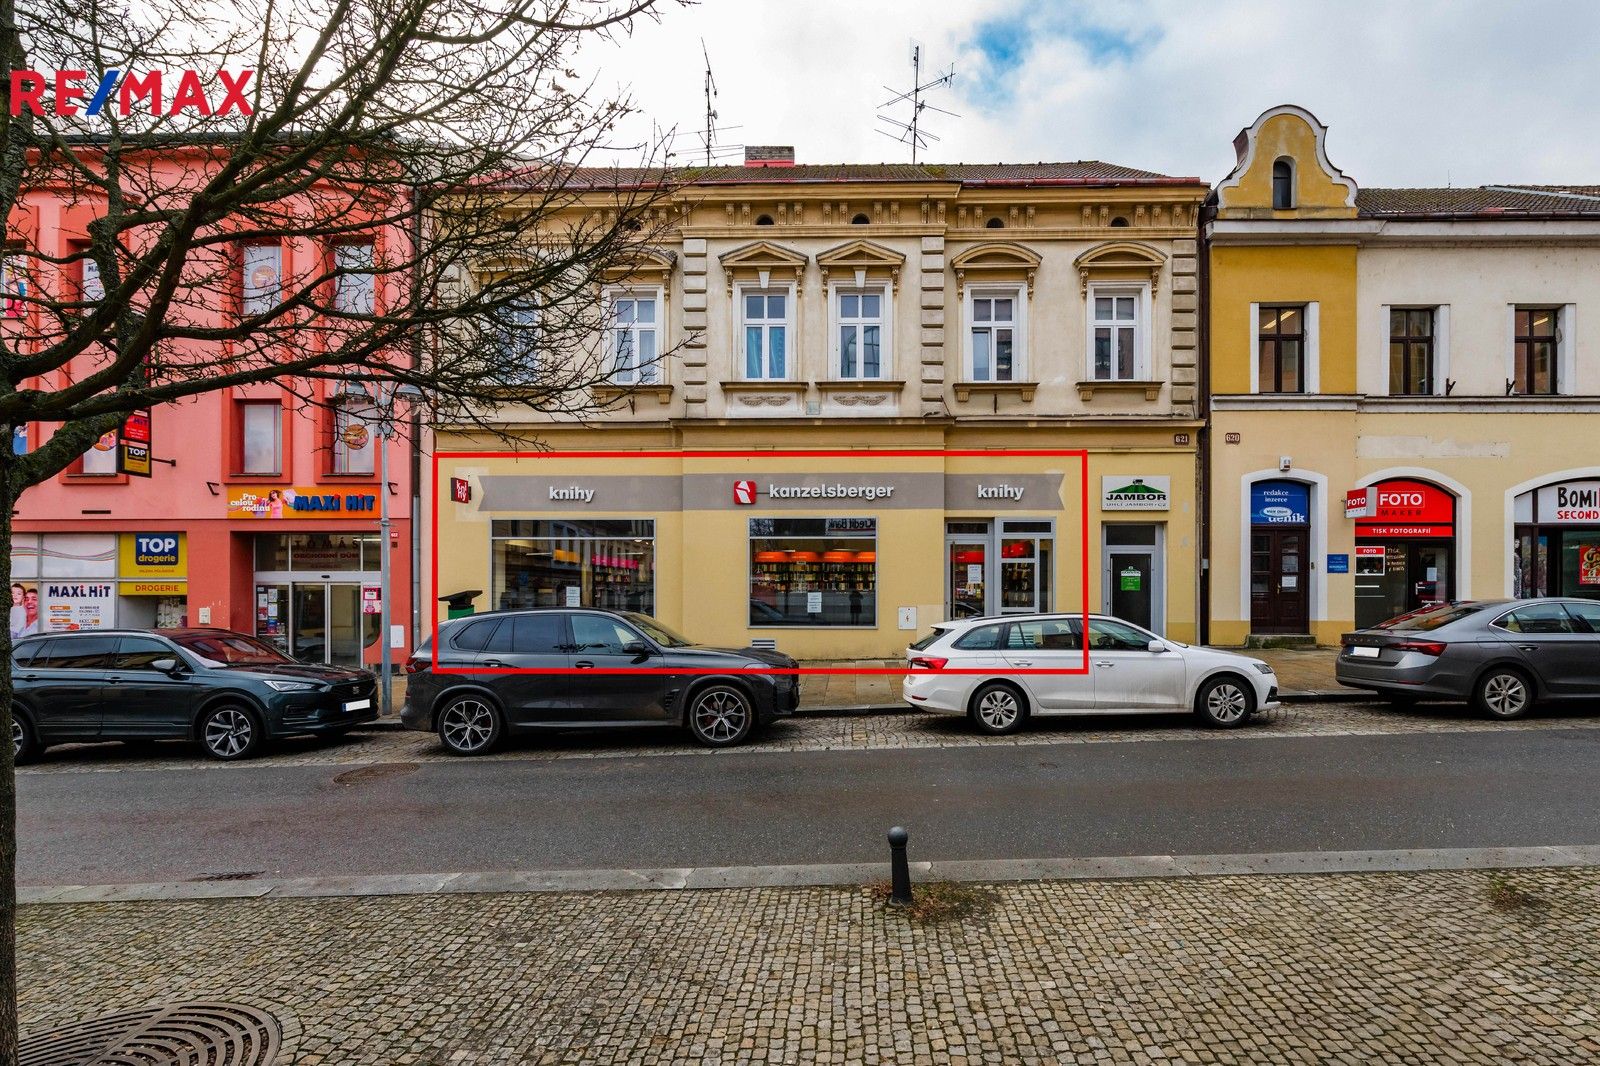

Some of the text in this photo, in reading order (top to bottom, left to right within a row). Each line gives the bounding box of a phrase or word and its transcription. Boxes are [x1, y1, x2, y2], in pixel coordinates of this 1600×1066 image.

[1175, 435, 1188, 443] 621
[1226, 433, 1240, 442] 620
[128, 447, 146, 456] TOP
[242, 493, 257, 501] Pro
[549, 486, 595, 503] knihy
[769, 484, 895, 501] kanzelsberger
[977, 484, 1025, 501] knihy
[1557, 486, 1600, 508] BOMI
[1347, 497, 1366, 507] FOTO
[1379, 493, 1423, 506] FOTO
[1557, 510, 1600, 520] SECOND
[138, 538, 176, 553] TOP
[138, 554, 176, 564] drogerie
[135, 584, 179, 592] DROGERIE
